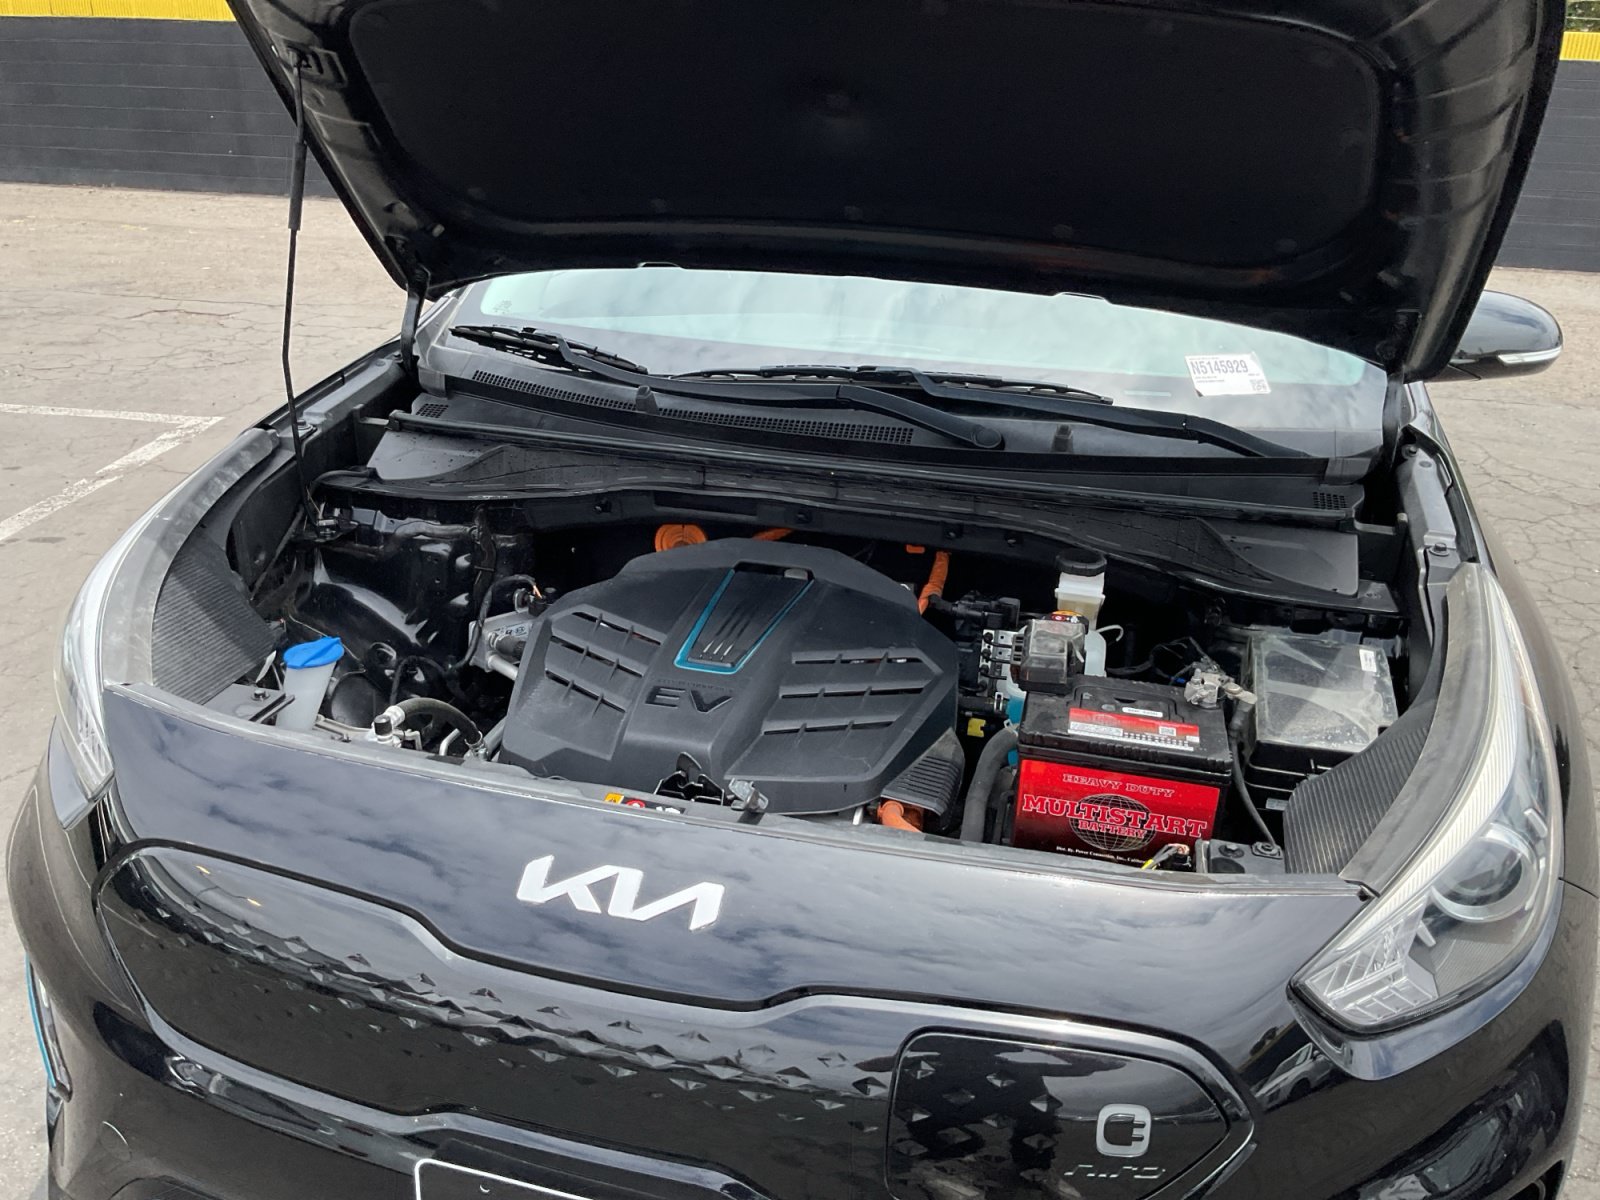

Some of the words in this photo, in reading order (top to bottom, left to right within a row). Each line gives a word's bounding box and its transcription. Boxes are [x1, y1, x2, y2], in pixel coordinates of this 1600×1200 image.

[1190, 359, 1249, 375] N5145929
[645, 685, 734, 713] EV
[1062, 773, 1123, 790] HEAVY
[1125, 782, 1175, 798] DUTY
[1022, 793, 1207, 839] MULTISTART
[1078, 819, 1148, 839] BATTERY
[516, 854, 725, 931] KIA
